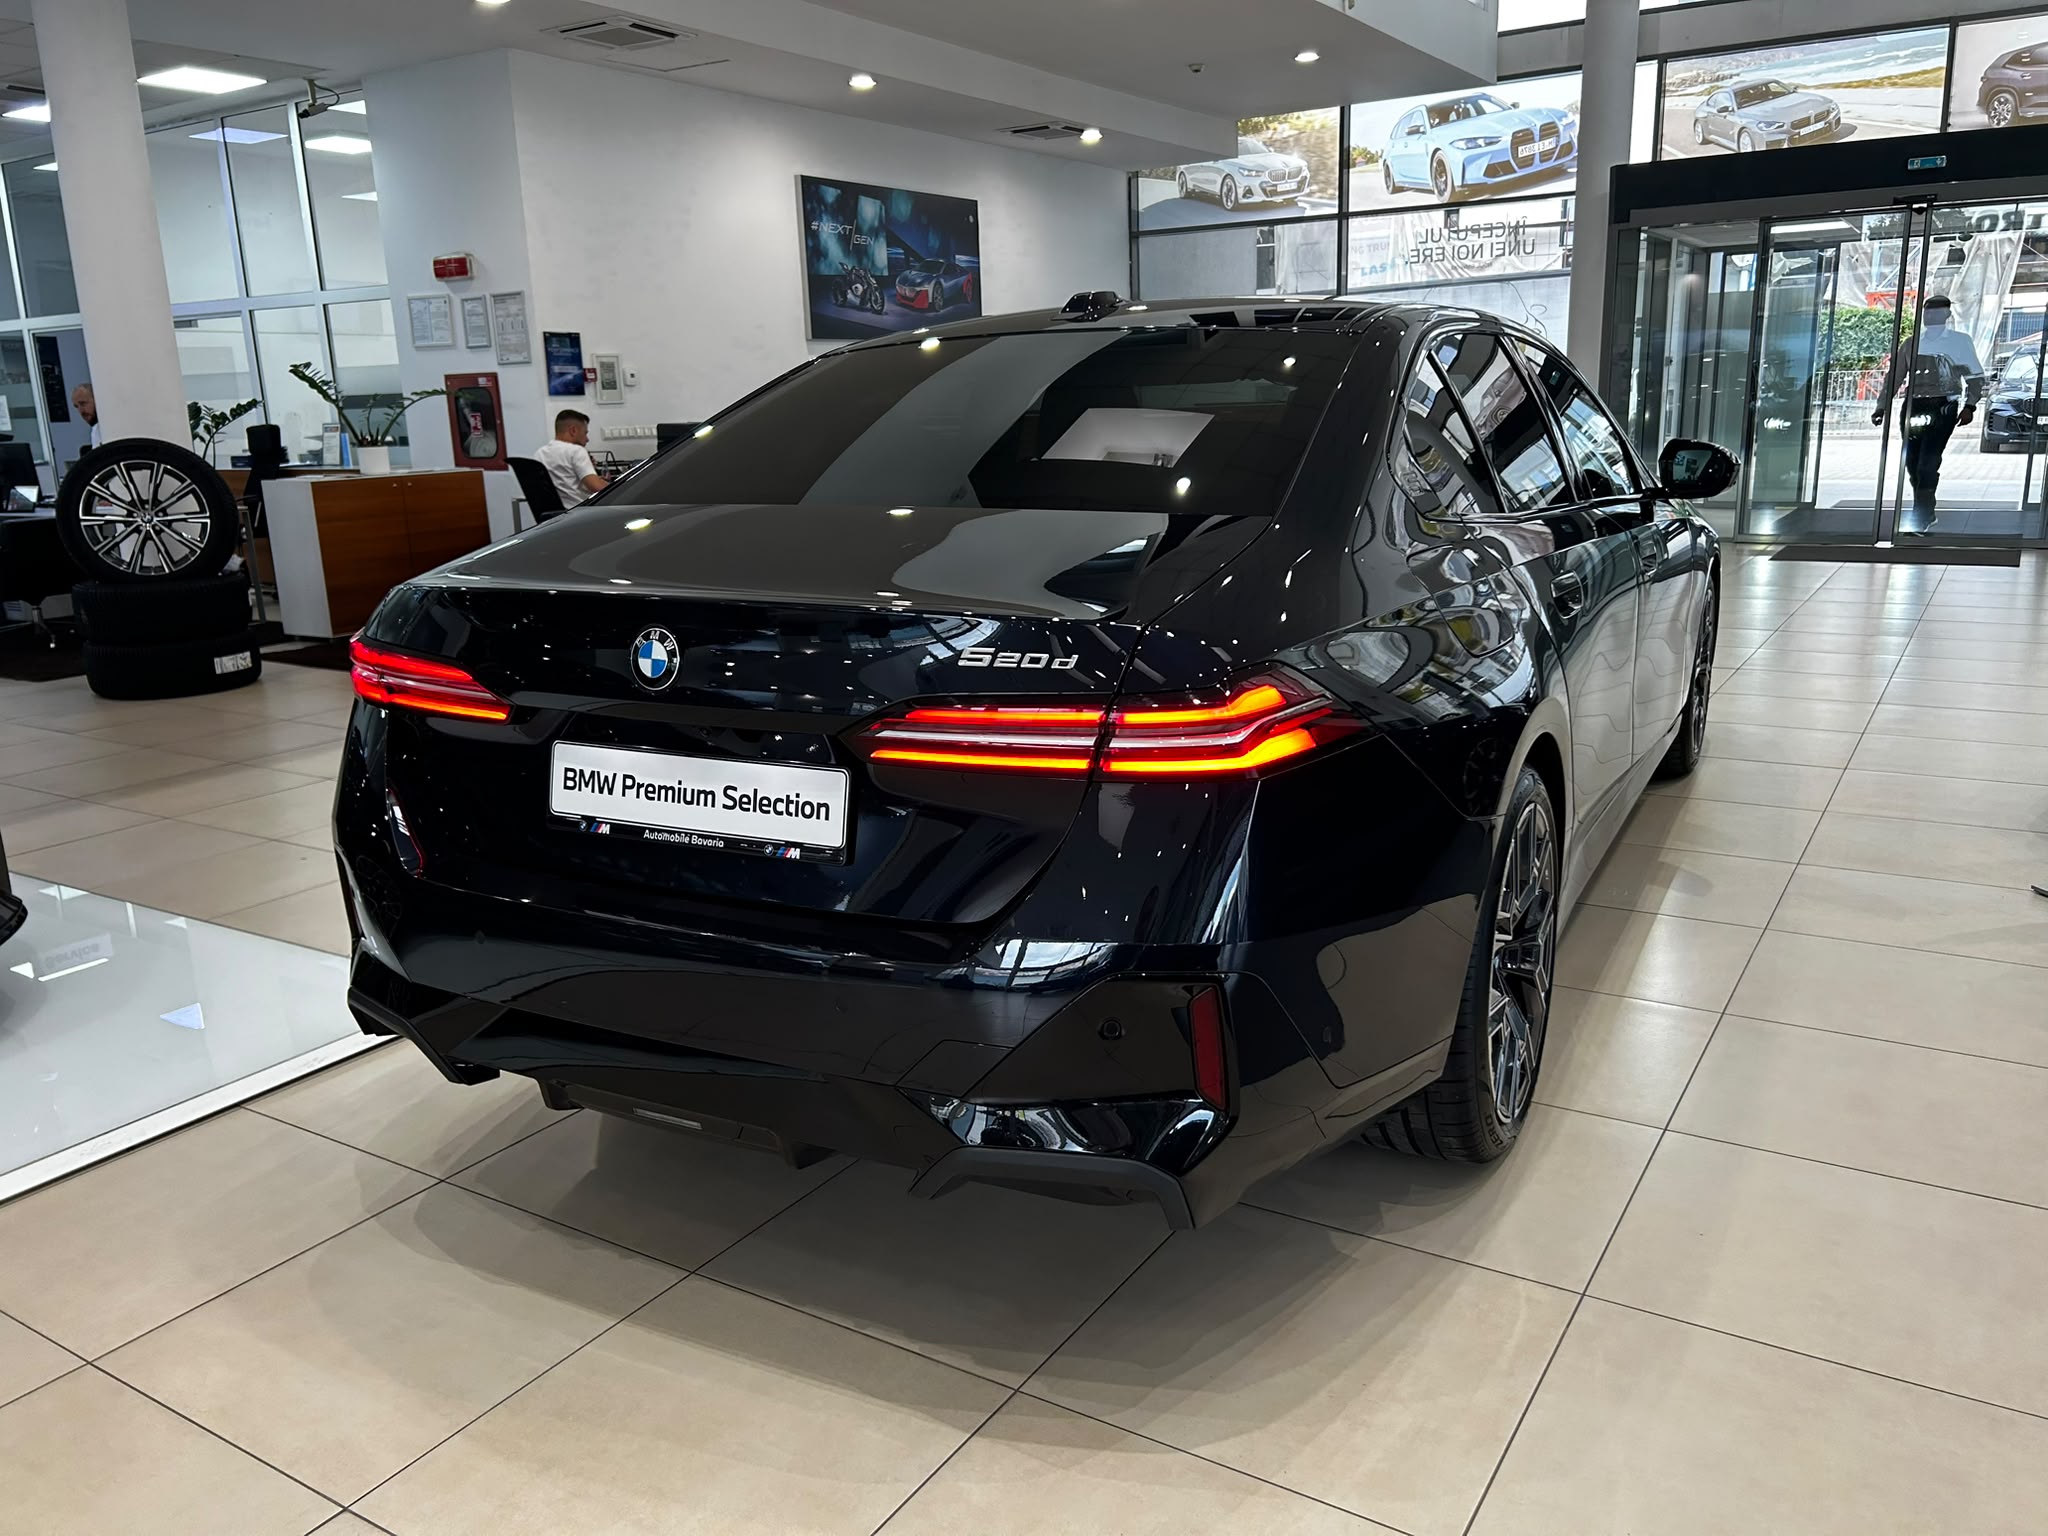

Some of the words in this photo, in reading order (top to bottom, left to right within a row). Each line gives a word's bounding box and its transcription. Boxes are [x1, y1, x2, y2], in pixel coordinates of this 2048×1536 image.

[810, 220, 853, 235] #NEXT
[853, 234, 875, 246] GEN
[636, 629, 675, 652] BMW
[957, 646, 1079, 670] 520d
[563, 767, 617, 796] BMW
[621, 774, 716, 808] Premium
[722, 785, 830, 821] Selection
[643, 829, 690, 844] Automobile
[691, 835, 724, 848] Bavaria
